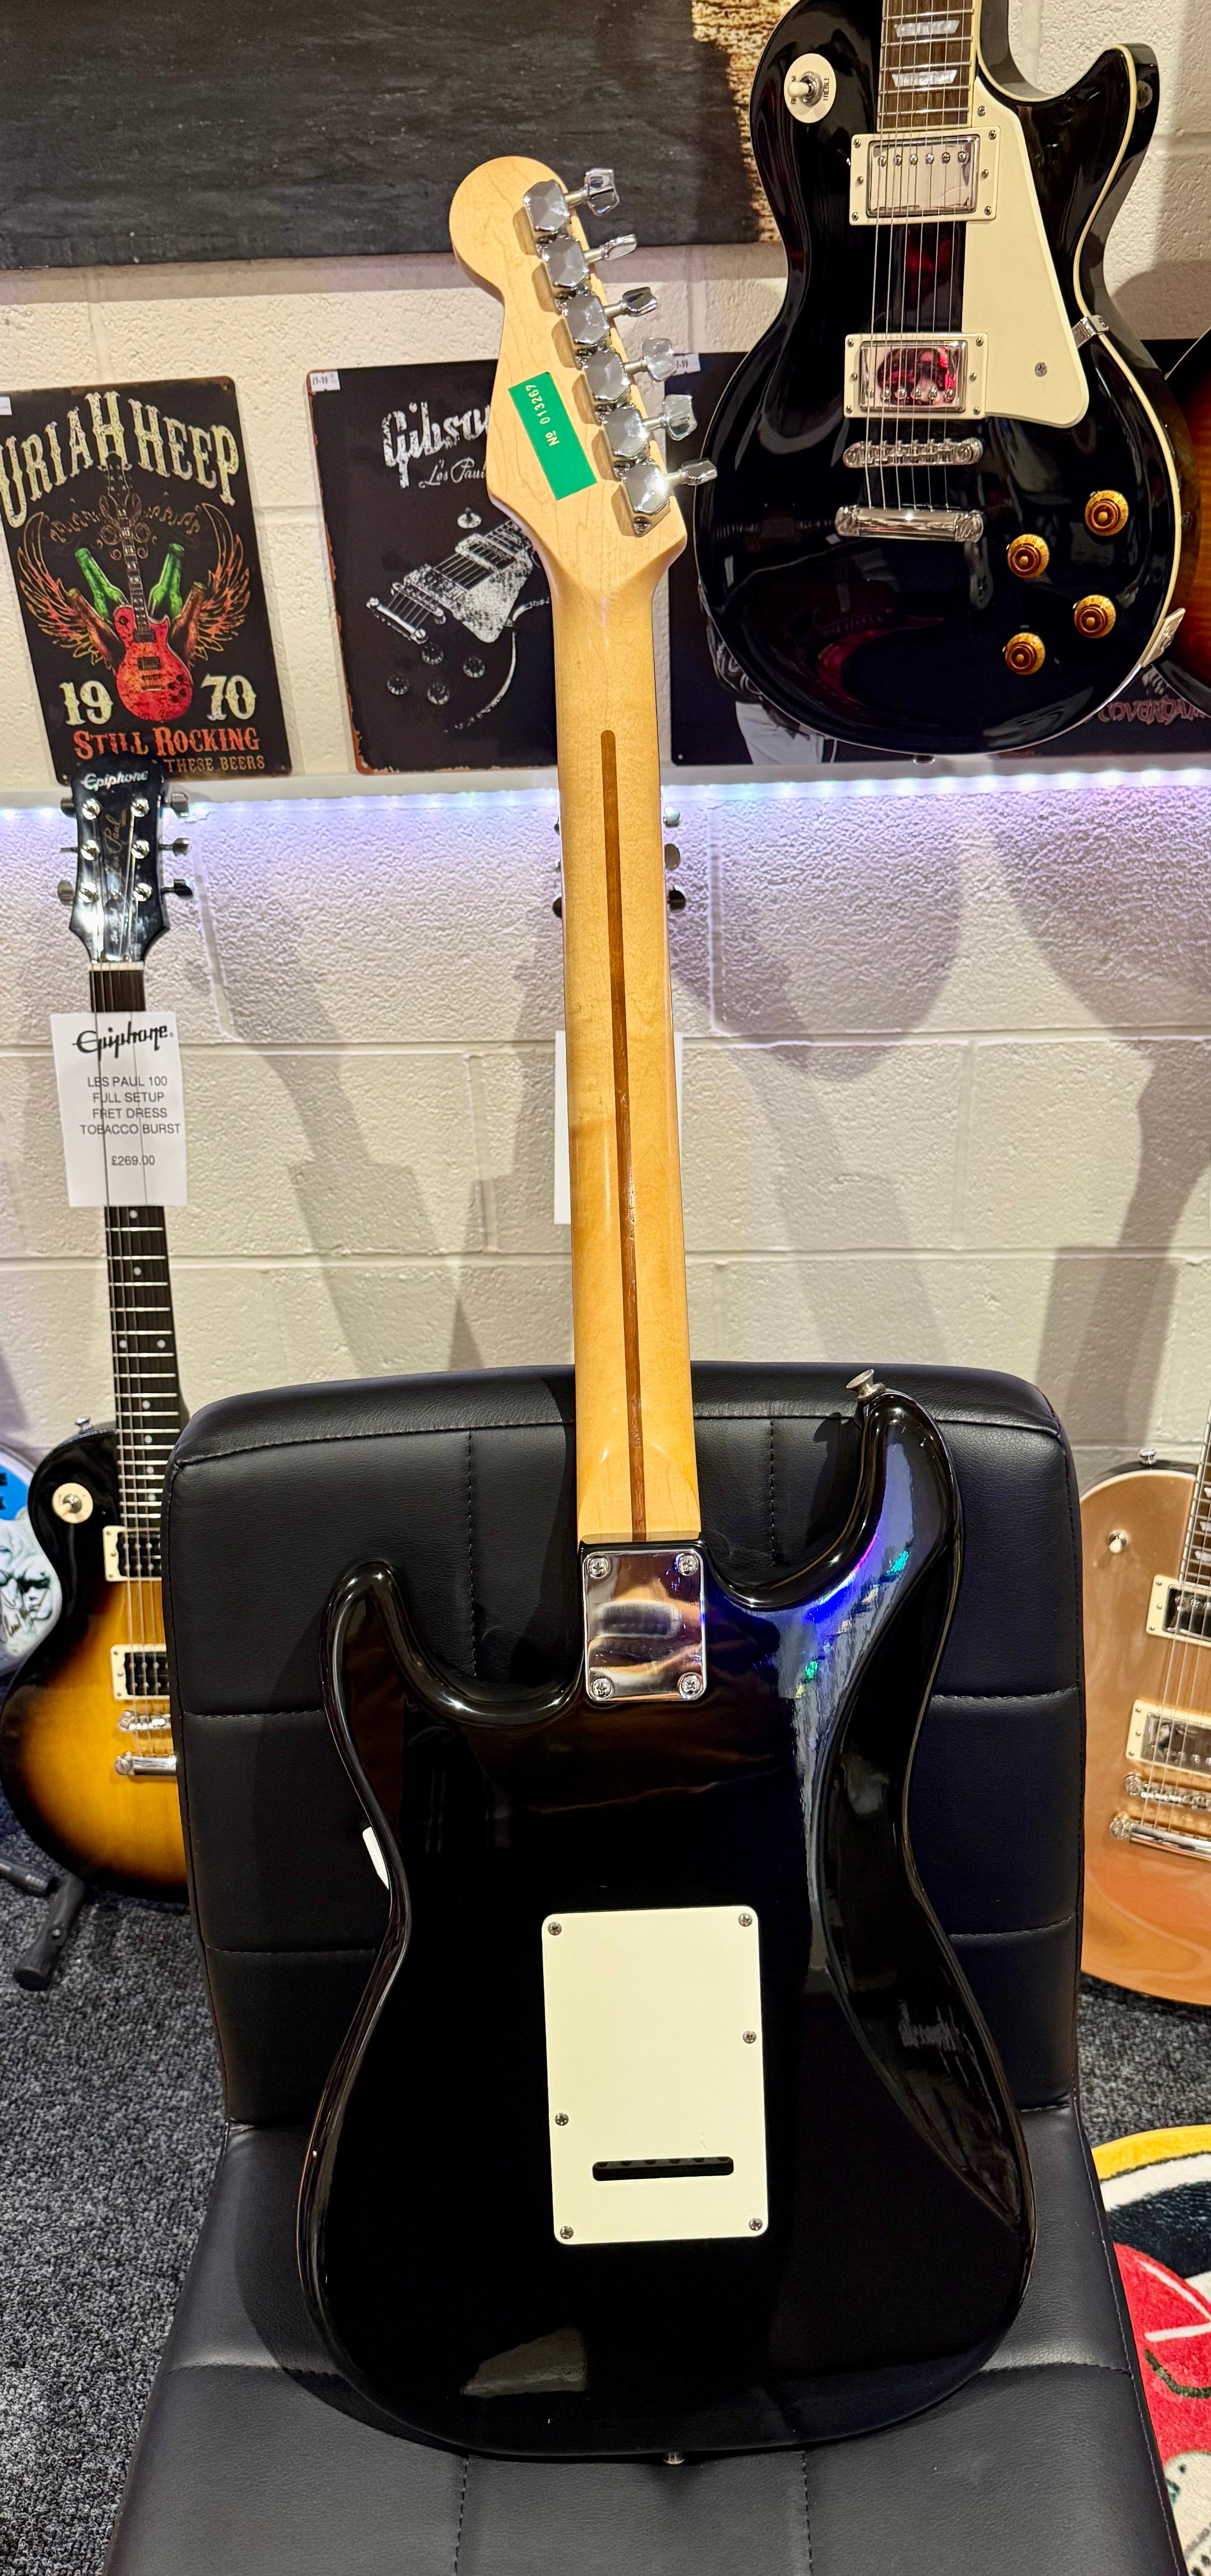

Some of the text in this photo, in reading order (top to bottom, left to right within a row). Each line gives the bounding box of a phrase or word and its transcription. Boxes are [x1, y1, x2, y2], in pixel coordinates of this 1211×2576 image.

[526, 385, 550, 424] 013267
[0, 391, 239, 528] URIAH HEEP
[418, 459, 448, 488] Les
[59, 674, 257, 725] 19 70
[73, 727, 260, 760] STILL ROCKING
[164, 755, 265, 773] THESE BEERS
[81, 771, 148, 790] Epiphone
[87, 1076, 168, 1087] LES PAUL 100
[93, 1092, 165, 1103] FULL SETUP
[93, 1108, 168, 1119] FRET DRESS
[80, 1123, 180, 1135] TOBACCO BURST
[111, 1155, 155, 1166] £269.00
